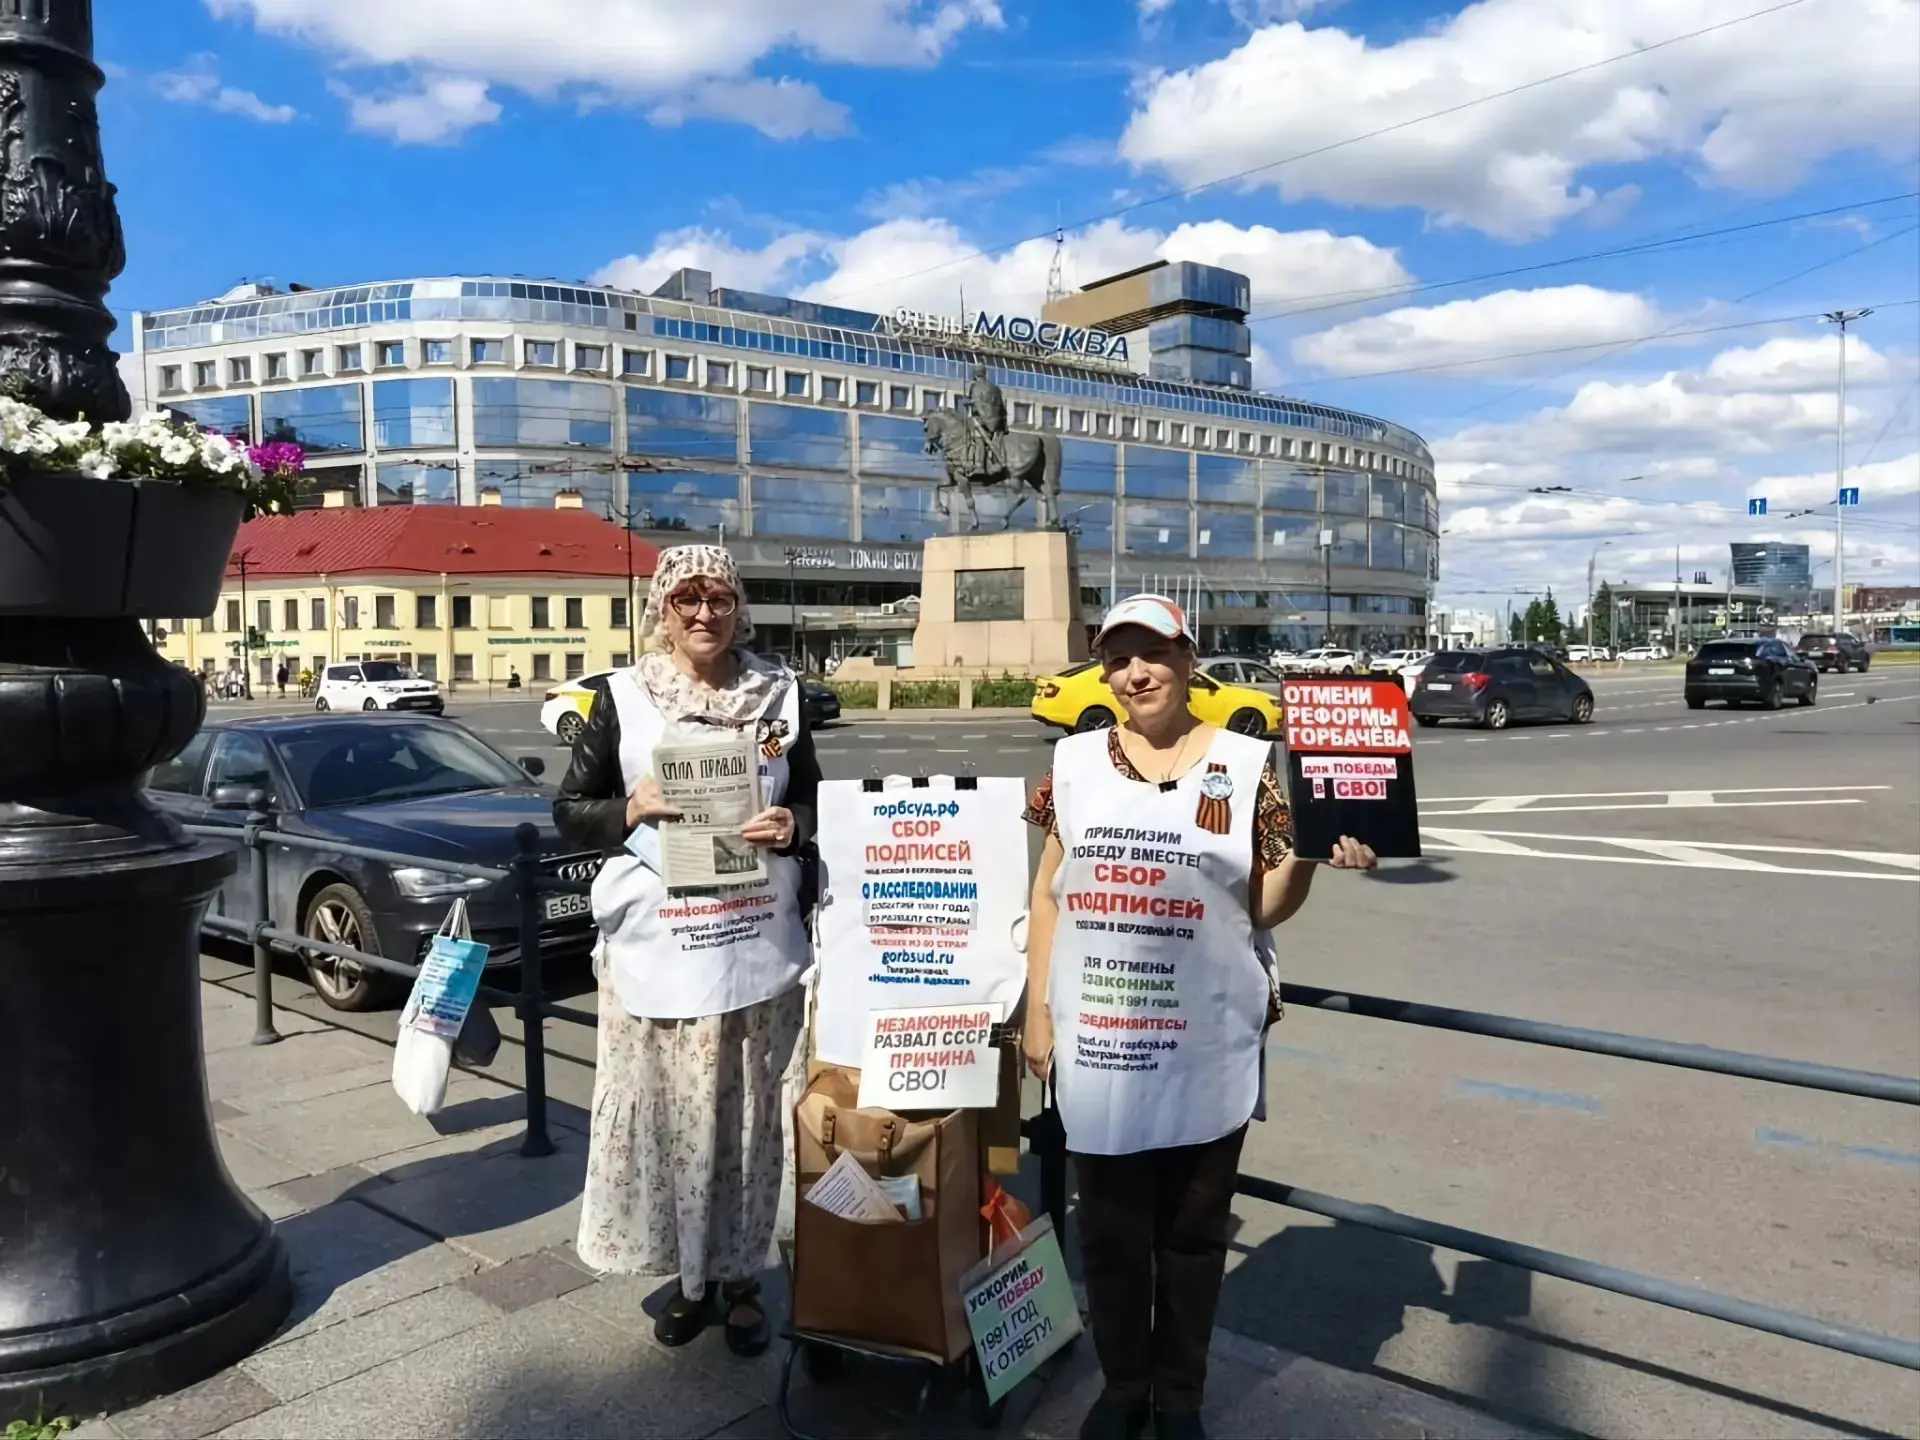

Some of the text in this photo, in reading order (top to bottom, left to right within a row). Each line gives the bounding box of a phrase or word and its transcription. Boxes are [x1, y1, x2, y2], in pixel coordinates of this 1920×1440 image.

[974, 310, 1129, 360] МОСКВА
[1284, 685, 1372, 705] ОТМЕНИ
[1287, 706, 1398, 726] РЕФОРМЫ
[1288, 725, 1412, 748] ГОРБАЧЁВА
[700, 756, 747, 779] ПРАВДЫ
[1304, 763, 1396, 775] для ПОБЕДЫ
[1336, 781, 1385, 796] СВО!
[873, 800, 959, 818] горбсуд.рф
[892, 820, 941, 837] СБОР
[1085, 827, 1182, 845] ПРИБЛИЗИМ
[865, 840, 971, 865] ПОДПИСЕЙ
[1095, 864, 1166, 886] СБОР
[862, 881, 977, 900] О РАССЛЕДОВАНИИ
[942, 903, 970, 913] ГОДА
[1067, 892, 1204, 920] ПОДПИСЕЙ
[926, 916, 970, 925] СТРАНЫ
[882, 949, 954, 965] gorbsud.ru
[1106, 959, 1175, 974] ОТМЕНЫ
[1118, 995, 1148, 1008] 1991
[1152, 999, 1180, 1009] года
[876, 1011, 990, 1033] НЕЗАКОННЫЙ
[874, 1029, 988, 1049] РАЗВАЛ СССР
[890, 1049, 976, 1068] ПРИЧИНА
[889, 1069, 947, 1091] СВО!
[968, 1260, 1029, 1314] УСКОРИМ
[997, 1266, 1044, 1311] ПОБЕДУ
[981, 1299, 1039, 1355] 1991 ГОД
[985, 1360, 997, 1380] К
